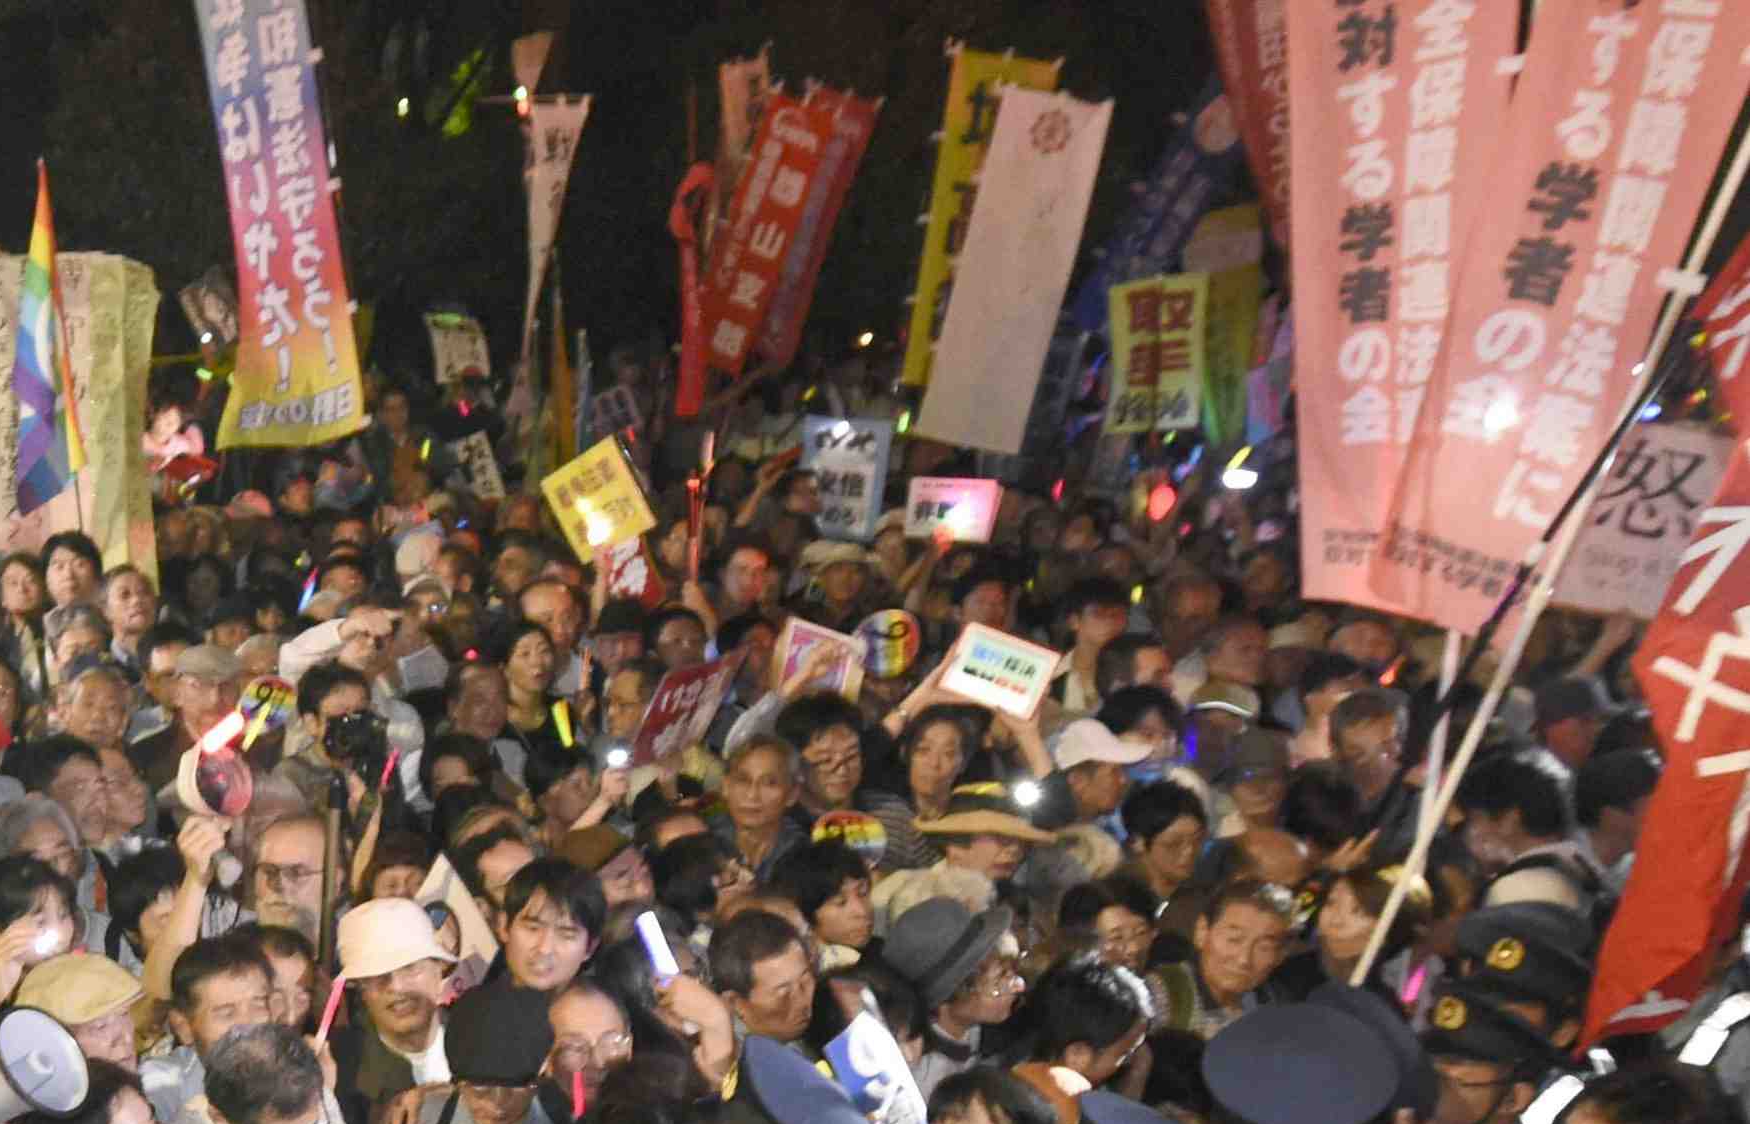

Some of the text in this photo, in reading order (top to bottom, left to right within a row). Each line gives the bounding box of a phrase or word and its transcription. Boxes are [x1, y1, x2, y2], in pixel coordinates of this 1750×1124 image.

[1336, 0, 1398, 445] 対する学者の会
[1442, 0, 1639, 444] する学者の会
[1493, 0, 1720, 528] 保障関連法案に
[1596, 437, 1706, 540] 怒
